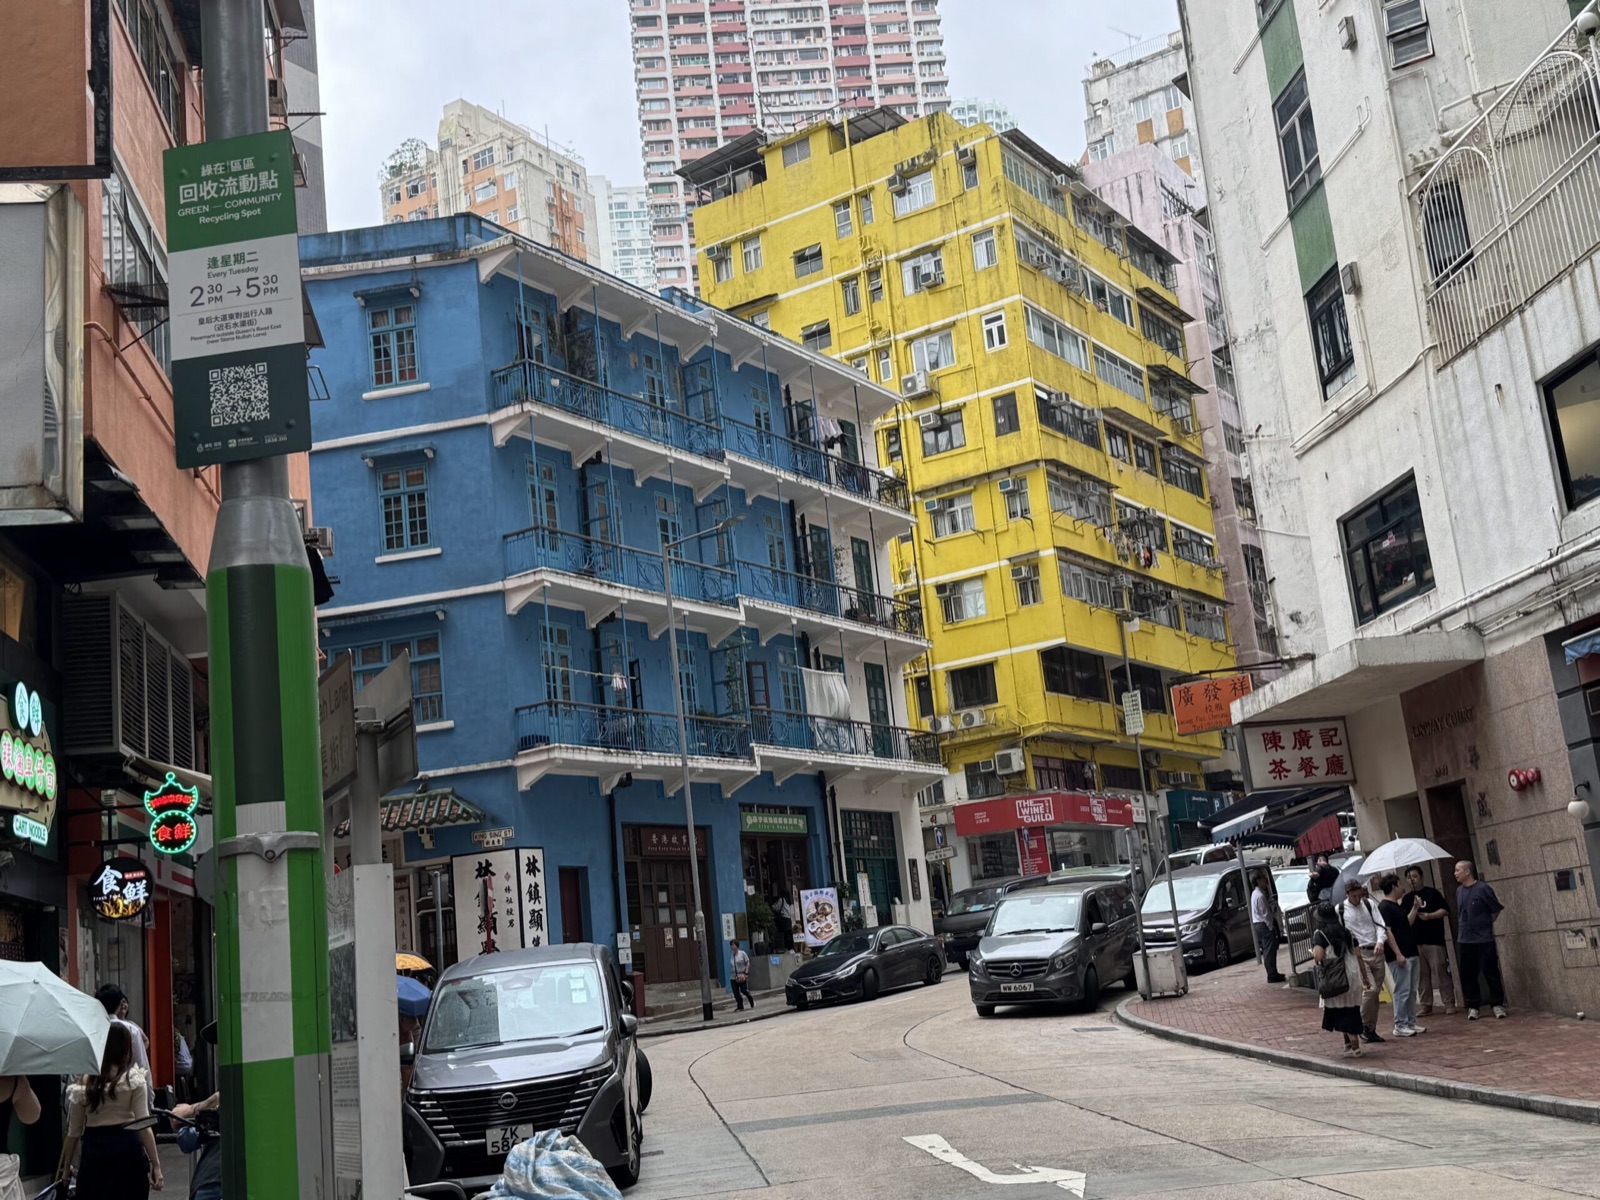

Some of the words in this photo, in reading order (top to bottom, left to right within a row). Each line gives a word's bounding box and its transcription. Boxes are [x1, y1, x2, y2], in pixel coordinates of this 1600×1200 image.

[179, 169, 279, 204] 回收流動點
[177, 204, 210, 217] GREEN
[224, 192, 282, 209] COMMUNITY
[199, 212, 240, 225] Recycling
[241, 207, 262, 218] Spot
[207, 251, 259, 269] 逢星期二
[207, 269, 227, 279] Every
[228, 265, 259, 277] Tuesday
[262, 274, 279, 286] 30
[190, 286, 205, 307] 2
[207, 283, 223, 294] 30
[245, 277, 261, 298] 5
[262, 286, 279, 297] PM
[207, 295, 223, 305] PM
[329, 680, 348, 715] Lane
[1177, 676, 1250, 708] 廣發祥
[1444, 706, 1475, 728] COURT
[1262, 727, 1343, 752] 陳廣記
[1268, 753, 1348, 780] 茶餐廳
[1018, 799, 1035, 807] THE
[1021, 806, 1045, 816] WINE
[1023, 813, 1052, 823] GUILD
[15, 816, 28, 835] CART
[29, 822, 46, 842] NOODLE
[156, 822, 191, 842] 食鮮
[474, 832, 487, 840] KING
[503, 829, 511, 837] ST
[651, 832, 698, 846] 香港故事
[93, 864, 149, 907] 食鮮
[1002, 984, 1012, 992] WW
[501, 1126, 519, 1140] ZK
